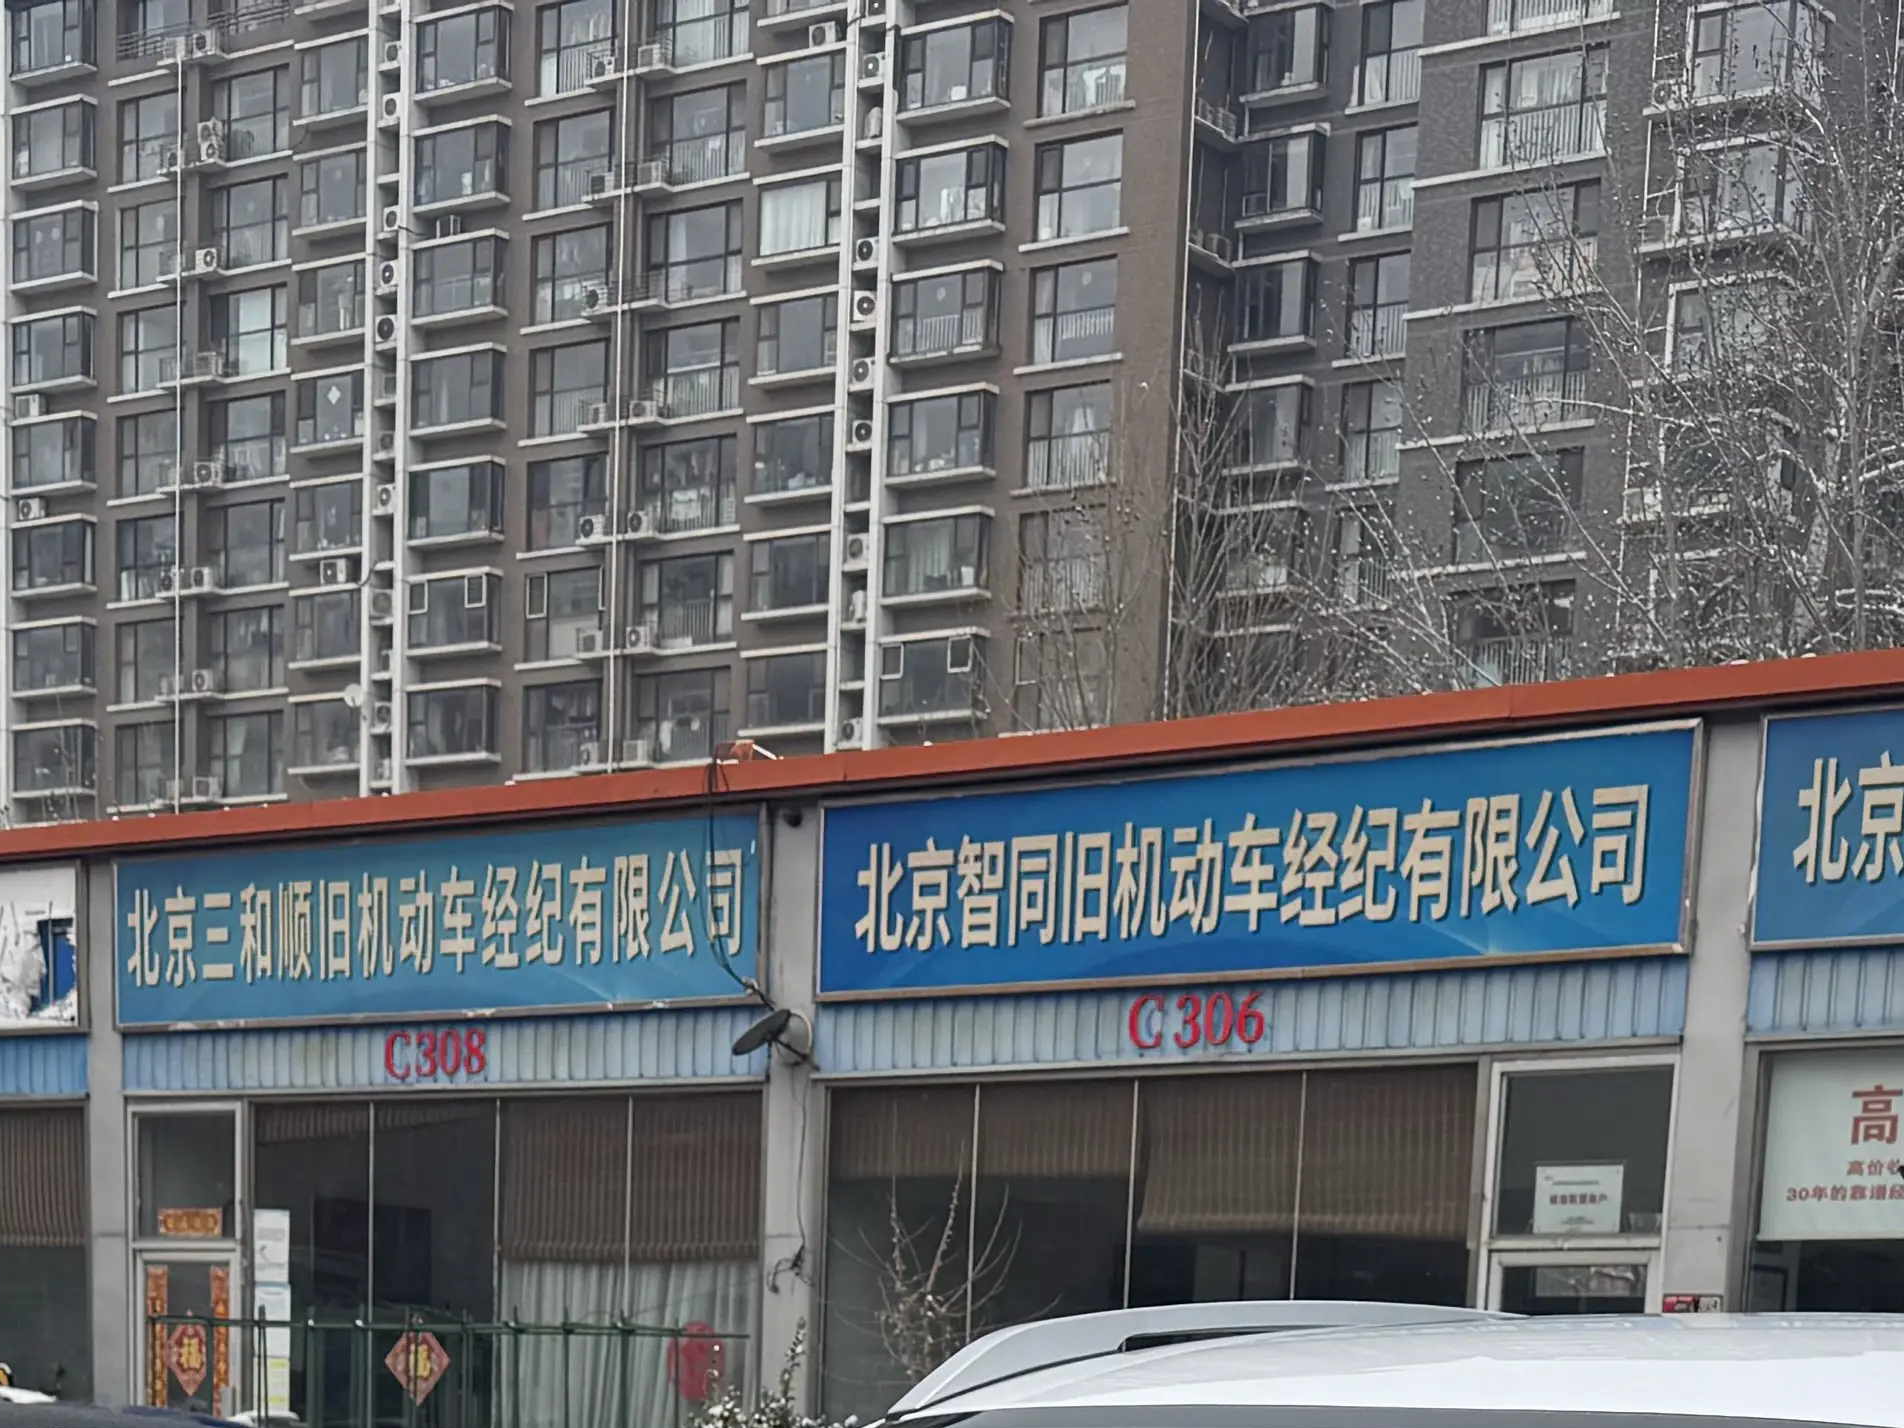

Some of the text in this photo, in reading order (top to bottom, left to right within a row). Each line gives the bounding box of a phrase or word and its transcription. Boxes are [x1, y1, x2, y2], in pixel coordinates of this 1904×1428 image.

[127, 848, 743, 988] 北京三和顺旧机动车经纪有限公司
[854, 784, 1651, 953] 北京智同旧机动车经纪有限公司
[384, 1028, 486, 1079] C308
[1128, 991, 1265, 1049] C306
